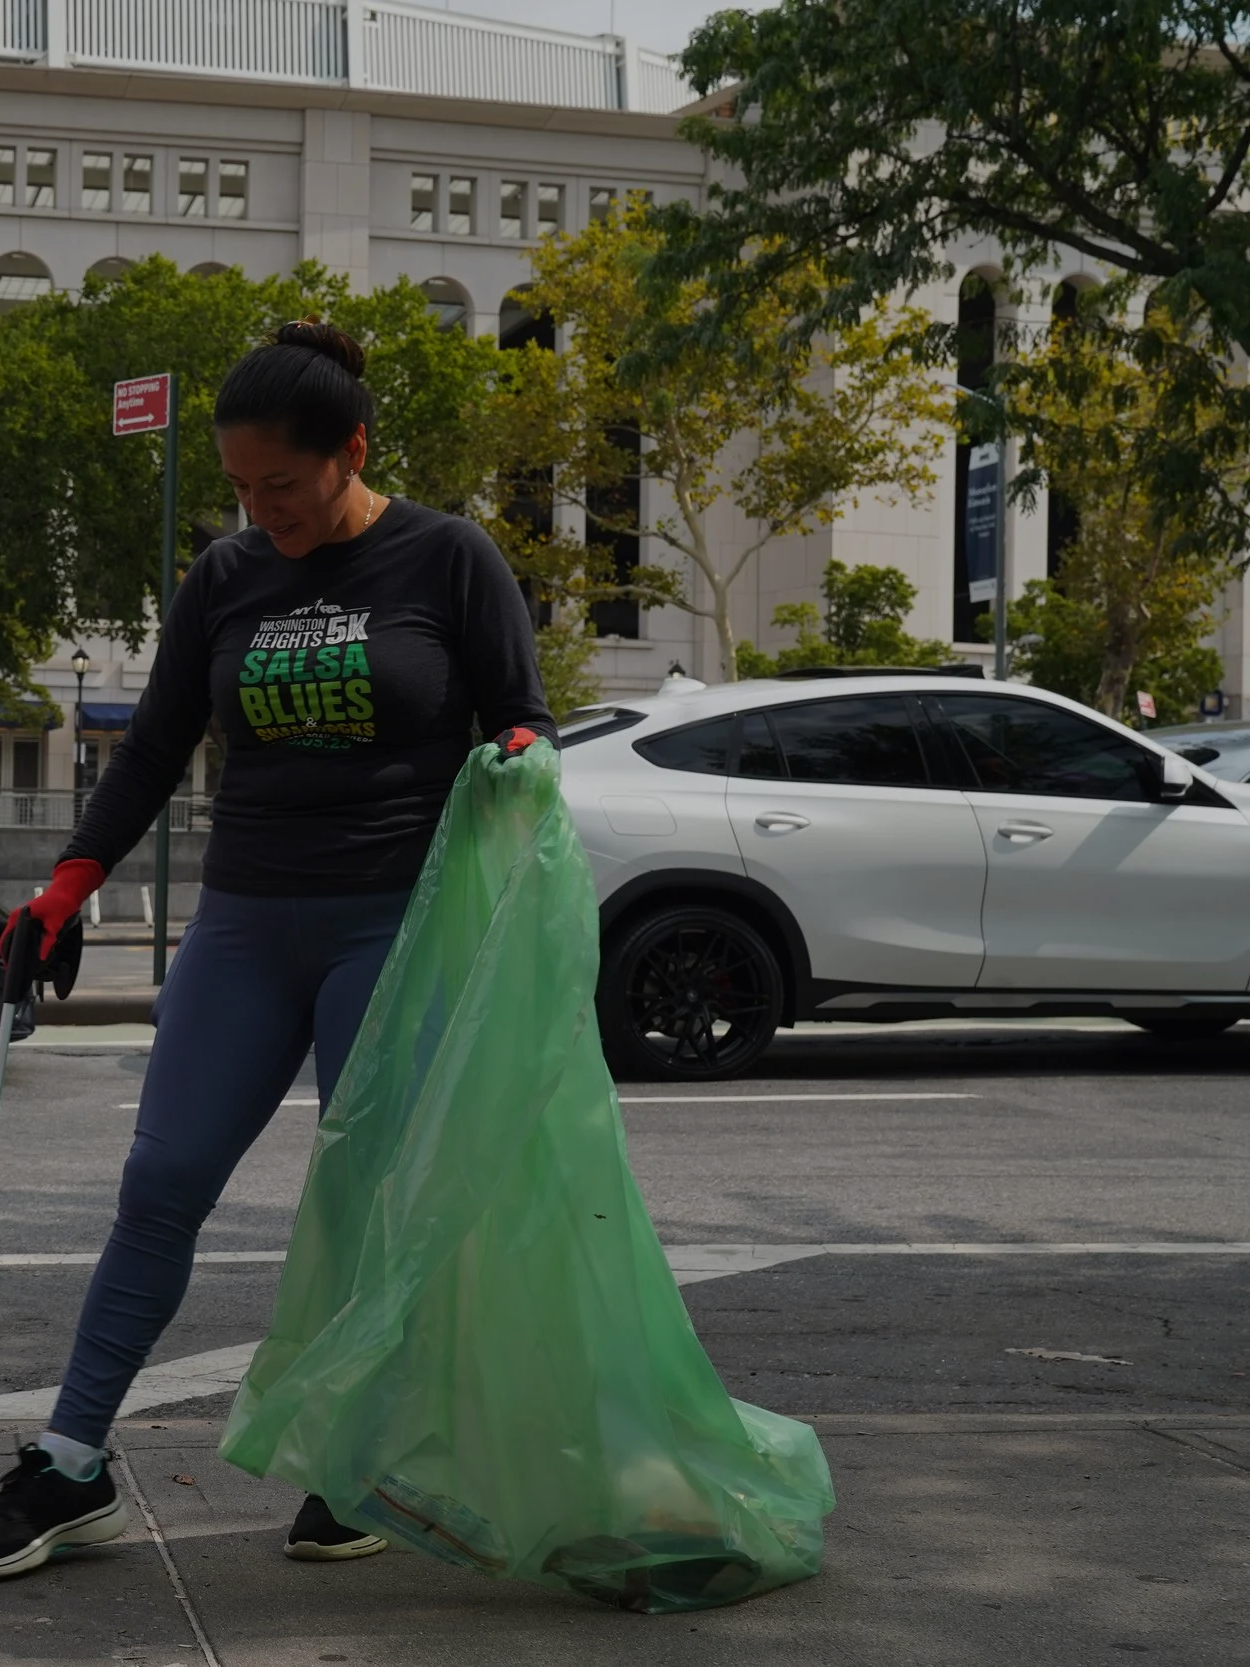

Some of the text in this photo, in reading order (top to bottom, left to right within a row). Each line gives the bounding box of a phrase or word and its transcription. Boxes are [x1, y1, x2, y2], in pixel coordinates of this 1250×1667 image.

[117, 381, 160, 397] NO STOPPING
[259, 618, 327, 632] WASHINGTON
[325, 612, 371, 645] 5K
[250, 631, 323, 649] HEIGHTS
[239, 643, 371, 685] SALSA
[239, 679, 374, 727] BLUES
[306, 717, 317, 728] &
